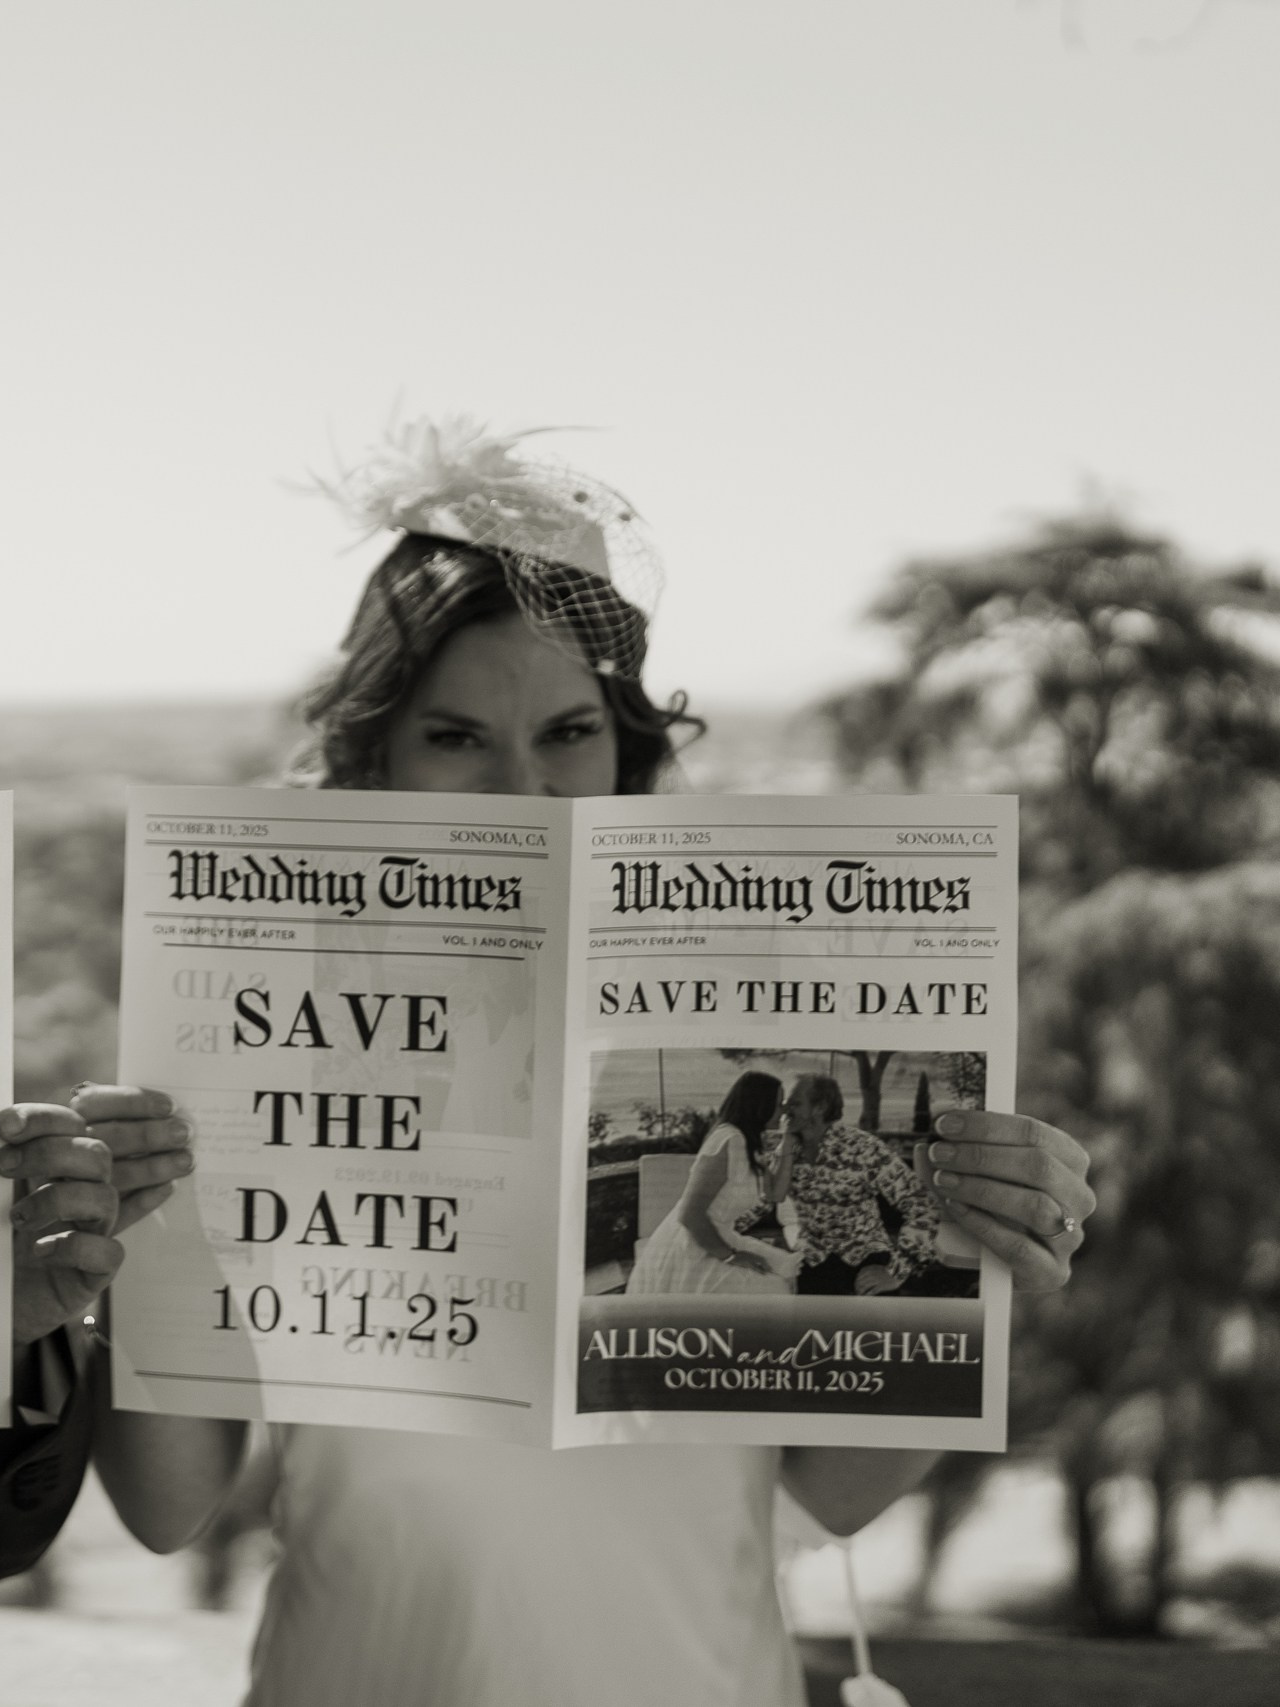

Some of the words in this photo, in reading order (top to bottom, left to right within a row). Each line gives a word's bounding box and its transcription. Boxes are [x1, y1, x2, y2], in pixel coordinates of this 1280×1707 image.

[147, 822, 217, 836] OCTOBER
[219, 823, 237, 838] 11,
[240, 823, 269, 838] 2025
[449, 830, 523, 847] SONOMA,
[526, 833, 547, 847] CA
[591, 833, 657, 846] OCTOBER
[661, 832, 679, 846] 11,
[682, 832, 711, 844] 2025
[896, 832, 970, 847] SONOMA,
[972, 832, 995, 846] CA
[168, 849, 367, 917] Wedding
[379, 856, 522, 912] Times
[611, 860, 814, 924] Wedding
[825, 860, 972, 915] Times
[153, 925, 177, 935] OUR
[180, 927, 224, 938] HAPPILY
[228, 928, 258, 939] EVER
[261, 929, 296, 941] AFTER
[480, 937, 506, 948] AND
[509, 939, 543, 950] ONLY
[589, 939, 607, 948] OUR
[610, 937, 647, 946] HAPPILY
[649, 936, 674, 946] EVER
[676, 936, 707, 945] AFTER
[946, 939, 968, 947] AND
[970, 939, 1000, 948] ONLY
[599, 980, 718, 1016] SAVE
[737, 981, 836, 1014] THE
[857, 982, 988, 1016] DATE
[234, 987, 447, 1052] SAVE
[254, 1090, 422, 1151] THE
[235, 1187, 458, 1253] DATE
[213, 1284, 479, 1347] 10.11.25
[583, 1326, 734, 1361] ALLISON
[811, 1330, 980, 1365] MICHAEL
[664, 1367, 792, 1390] OCTOBER
[797, 1369, 820, 1392] 11,
[825, 1370, 885, 1394] 2025
